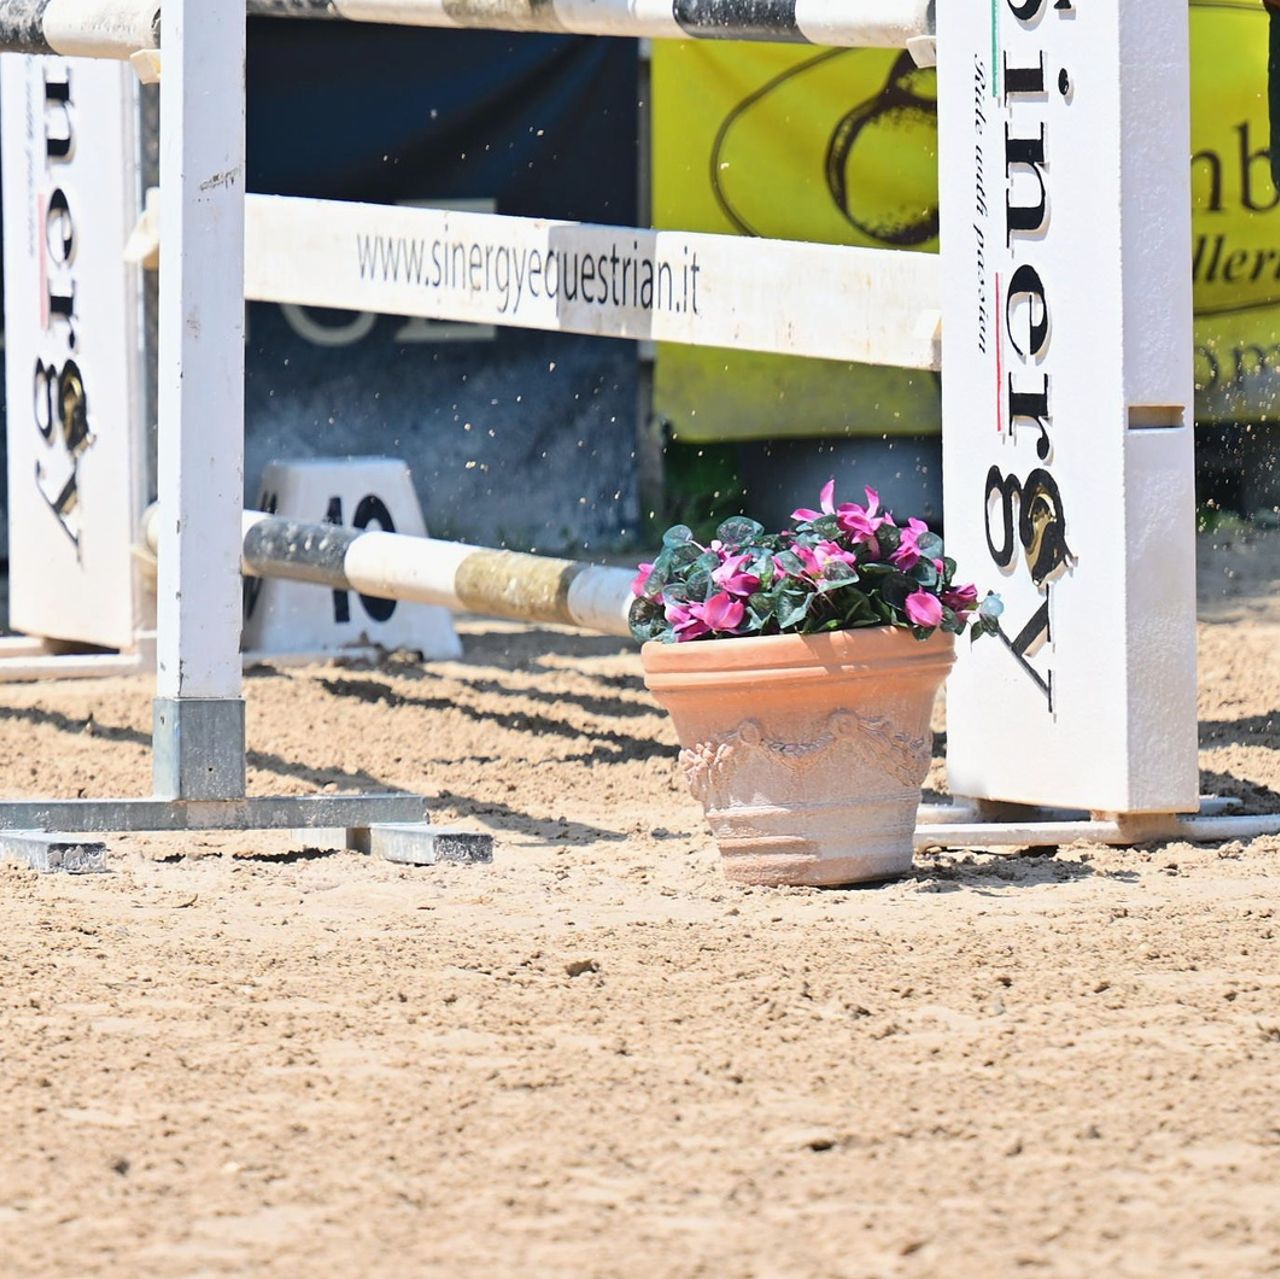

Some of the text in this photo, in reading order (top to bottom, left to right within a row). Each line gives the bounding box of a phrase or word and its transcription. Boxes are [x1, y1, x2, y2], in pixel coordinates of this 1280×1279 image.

[974, 53, 987, 136] Ride
[356, 222, 701, 322] www.sinergyequestrian.it
[972, 223, 988, 354] passion
